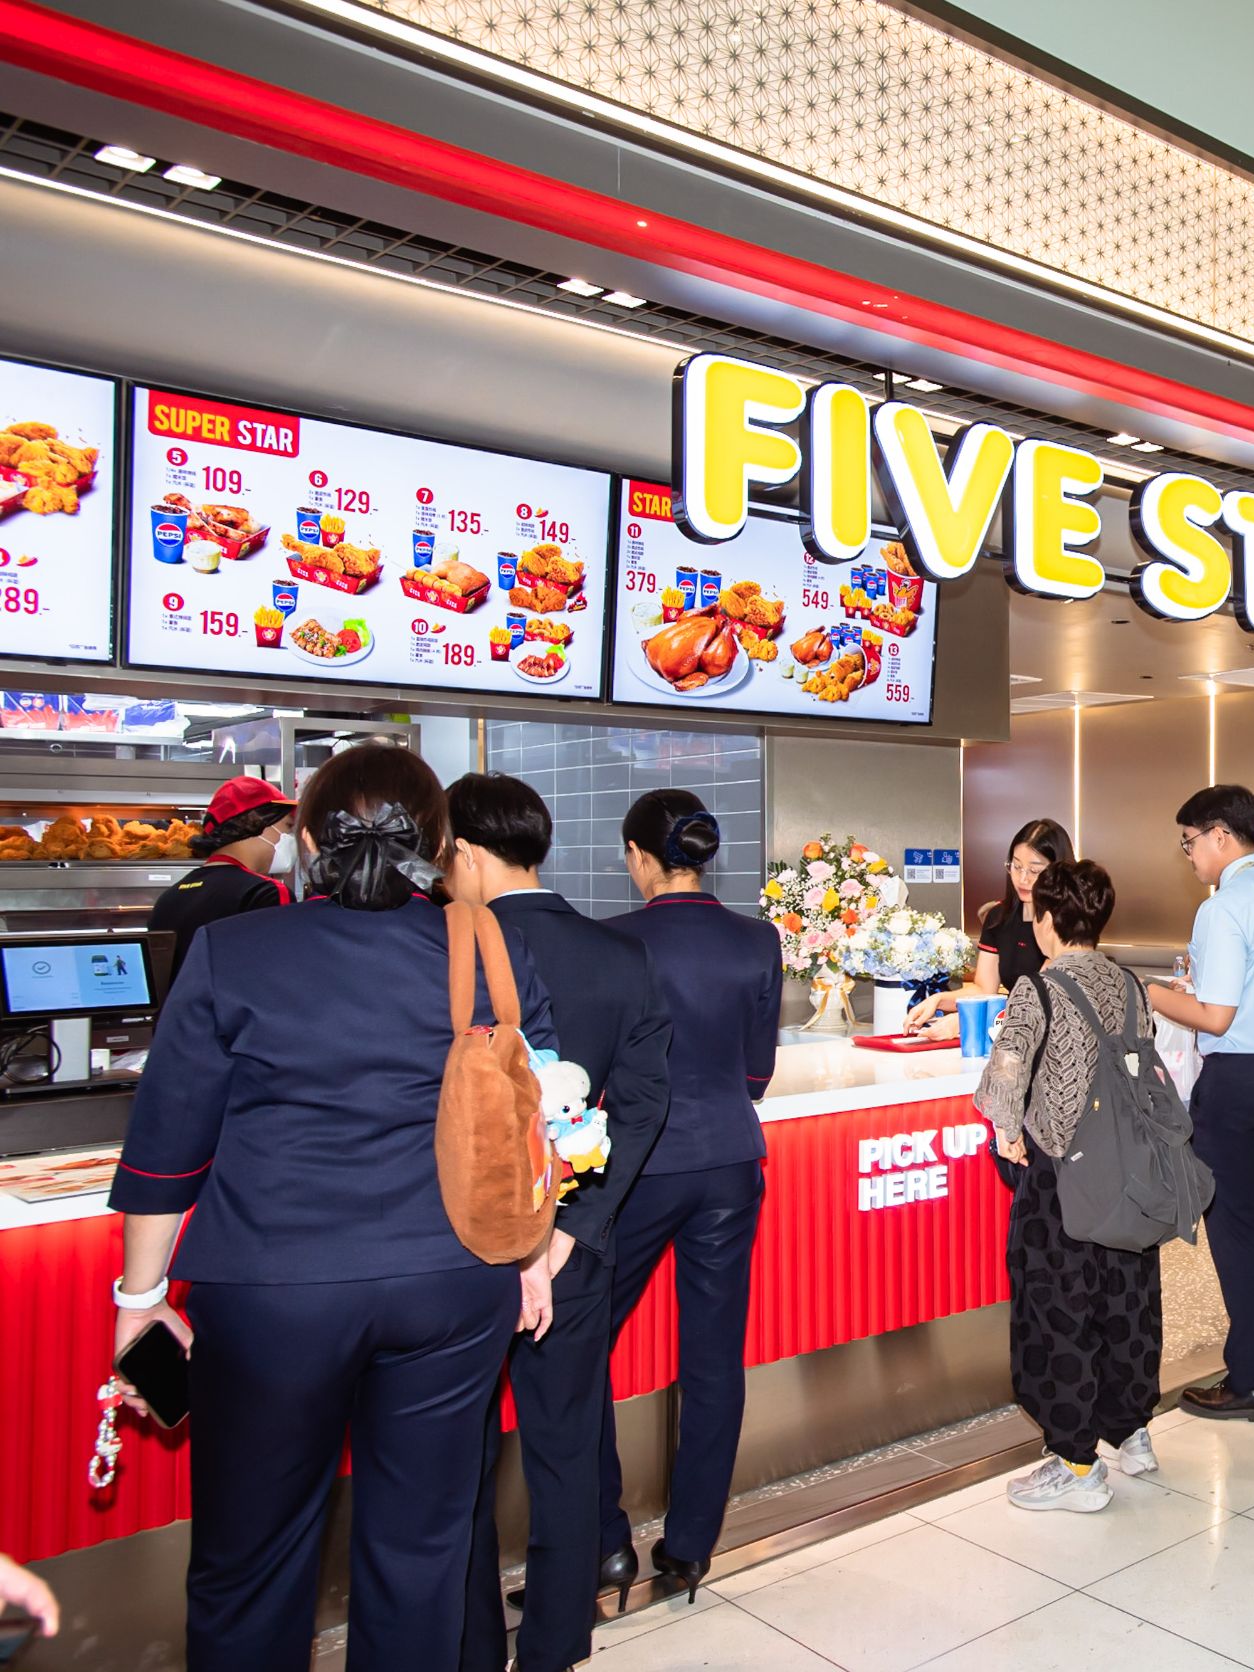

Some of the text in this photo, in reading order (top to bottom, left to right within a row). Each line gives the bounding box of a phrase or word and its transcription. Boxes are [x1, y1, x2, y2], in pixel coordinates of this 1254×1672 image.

[153, 404, 294, 453] SUPER STAR
[171, 450, 183, 464] 5
[313, 473, 323, 486] 6
[674, 352, 1105, 599] FIVE
[421, 490, 429, 503] 7
[632, 492, 672, 518] STAR
[520, 506, 528, 518] 8
[156, 530, 182, 539] PEPSI
[629, 526, 639, 537] 11
[0, 585, 50, 615] 89.-
[168, 595, 180, 608] 9
[413, 621, 427, 633] 10
[888, 645, 898, 654] 13
[858, 1123, 987, 1173] PICK UP
[858, 1164, 948, 1211] HERE
